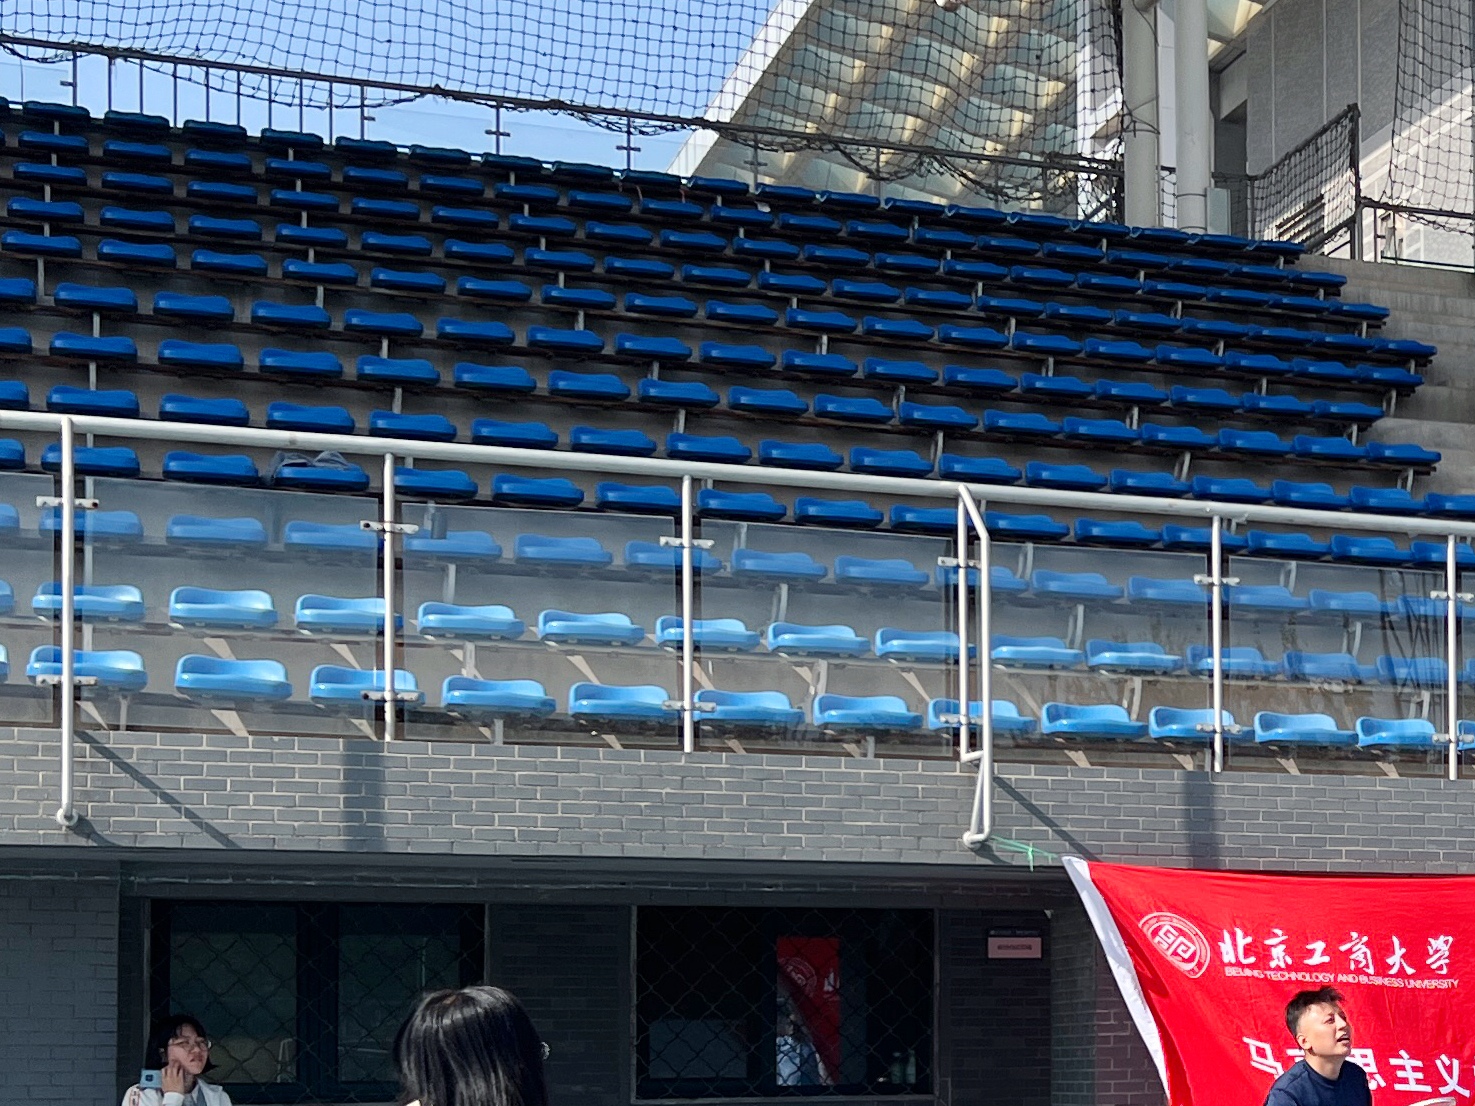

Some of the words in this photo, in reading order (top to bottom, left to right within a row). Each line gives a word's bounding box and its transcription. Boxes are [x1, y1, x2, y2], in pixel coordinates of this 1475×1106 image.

[1264, 970, 1335, 983] TECHNOLOGY
[1338, 973, 1359, 983] AND
[1359, 974, 1404, 987] BUSINESS
[1405, 979, 1459, 989] UNIVERSITY
